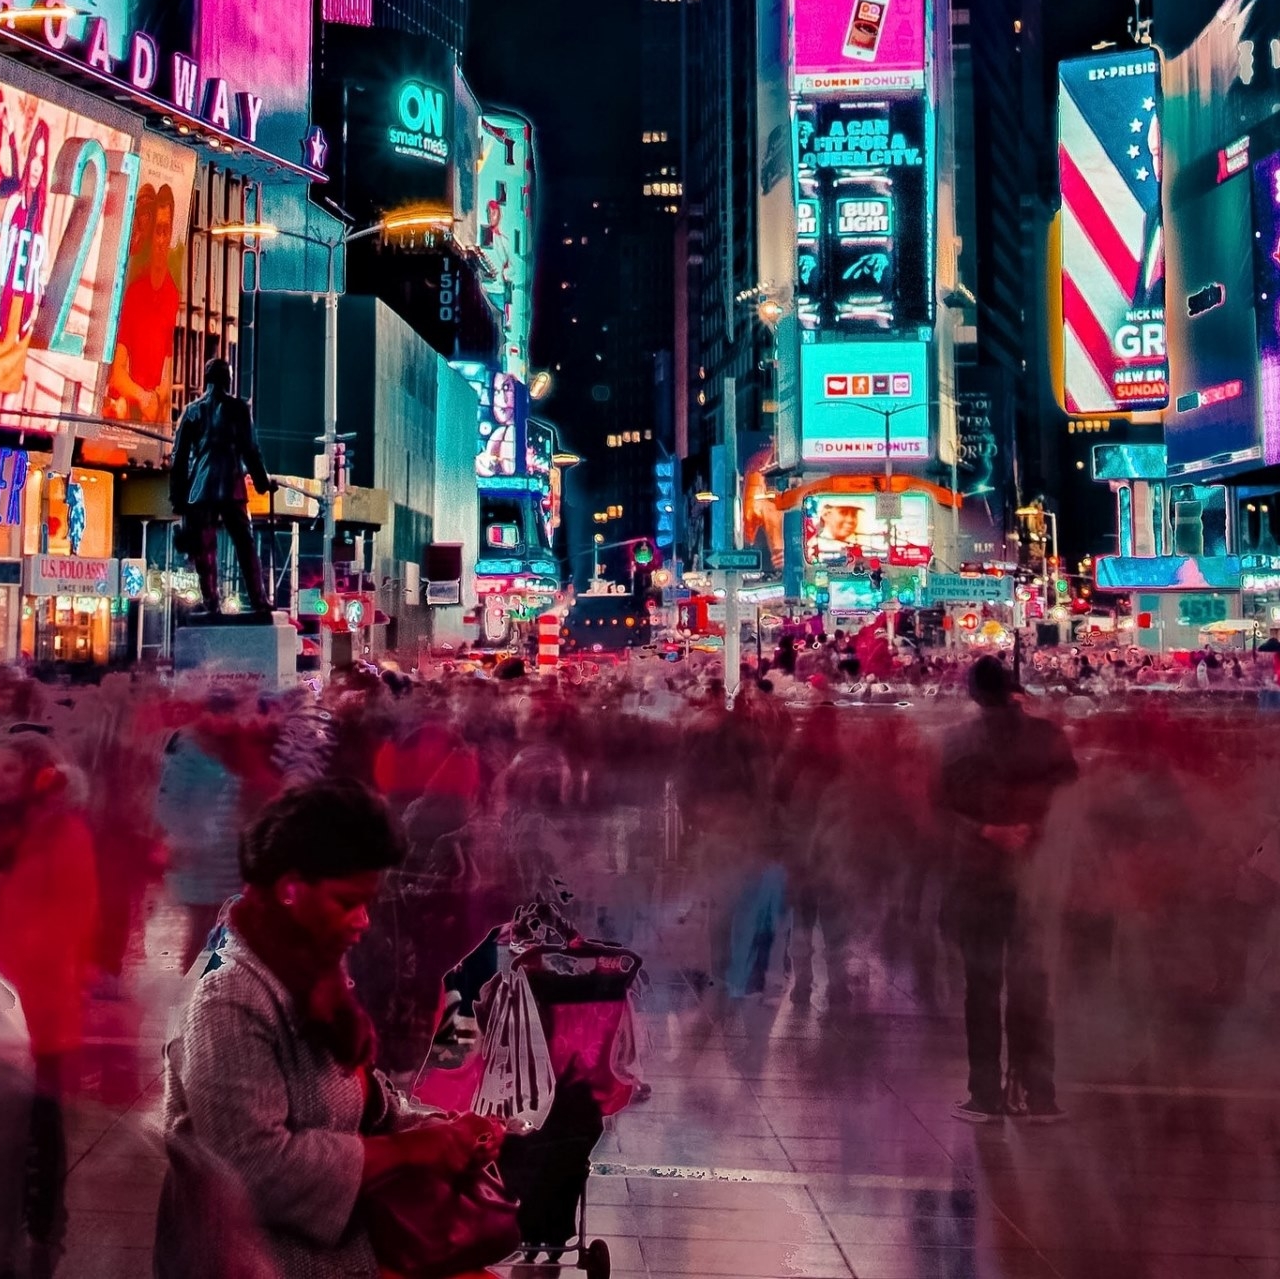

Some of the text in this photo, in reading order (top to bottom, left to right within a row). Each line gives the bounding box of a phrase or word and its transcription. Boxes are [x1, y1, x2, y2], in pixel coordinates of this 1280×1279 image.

[864, 76, 910, 86] DONUTS
[399, 84, 443, 137] ON
[829, 119, 889, 136] A CAN
[390, 129, 423, 148] smart
[423, 137, 449, 157] media
[814, 133, 906, 152] FIT FOR A
[802, 150, 868, 168] QUEEN
[843, 201, 884, 217] BUD
[838, 216, 889, 232] LIGHT
[48, 138, 140, 364] 21
[439, 257, 453, 320] 1500
[1126, 310, 1150, 321] NICK
[1114, 371, 1141, 382] NEW
[877, 441, 920, 451] DONUTS
[58, 560, 83, 579] POLO
